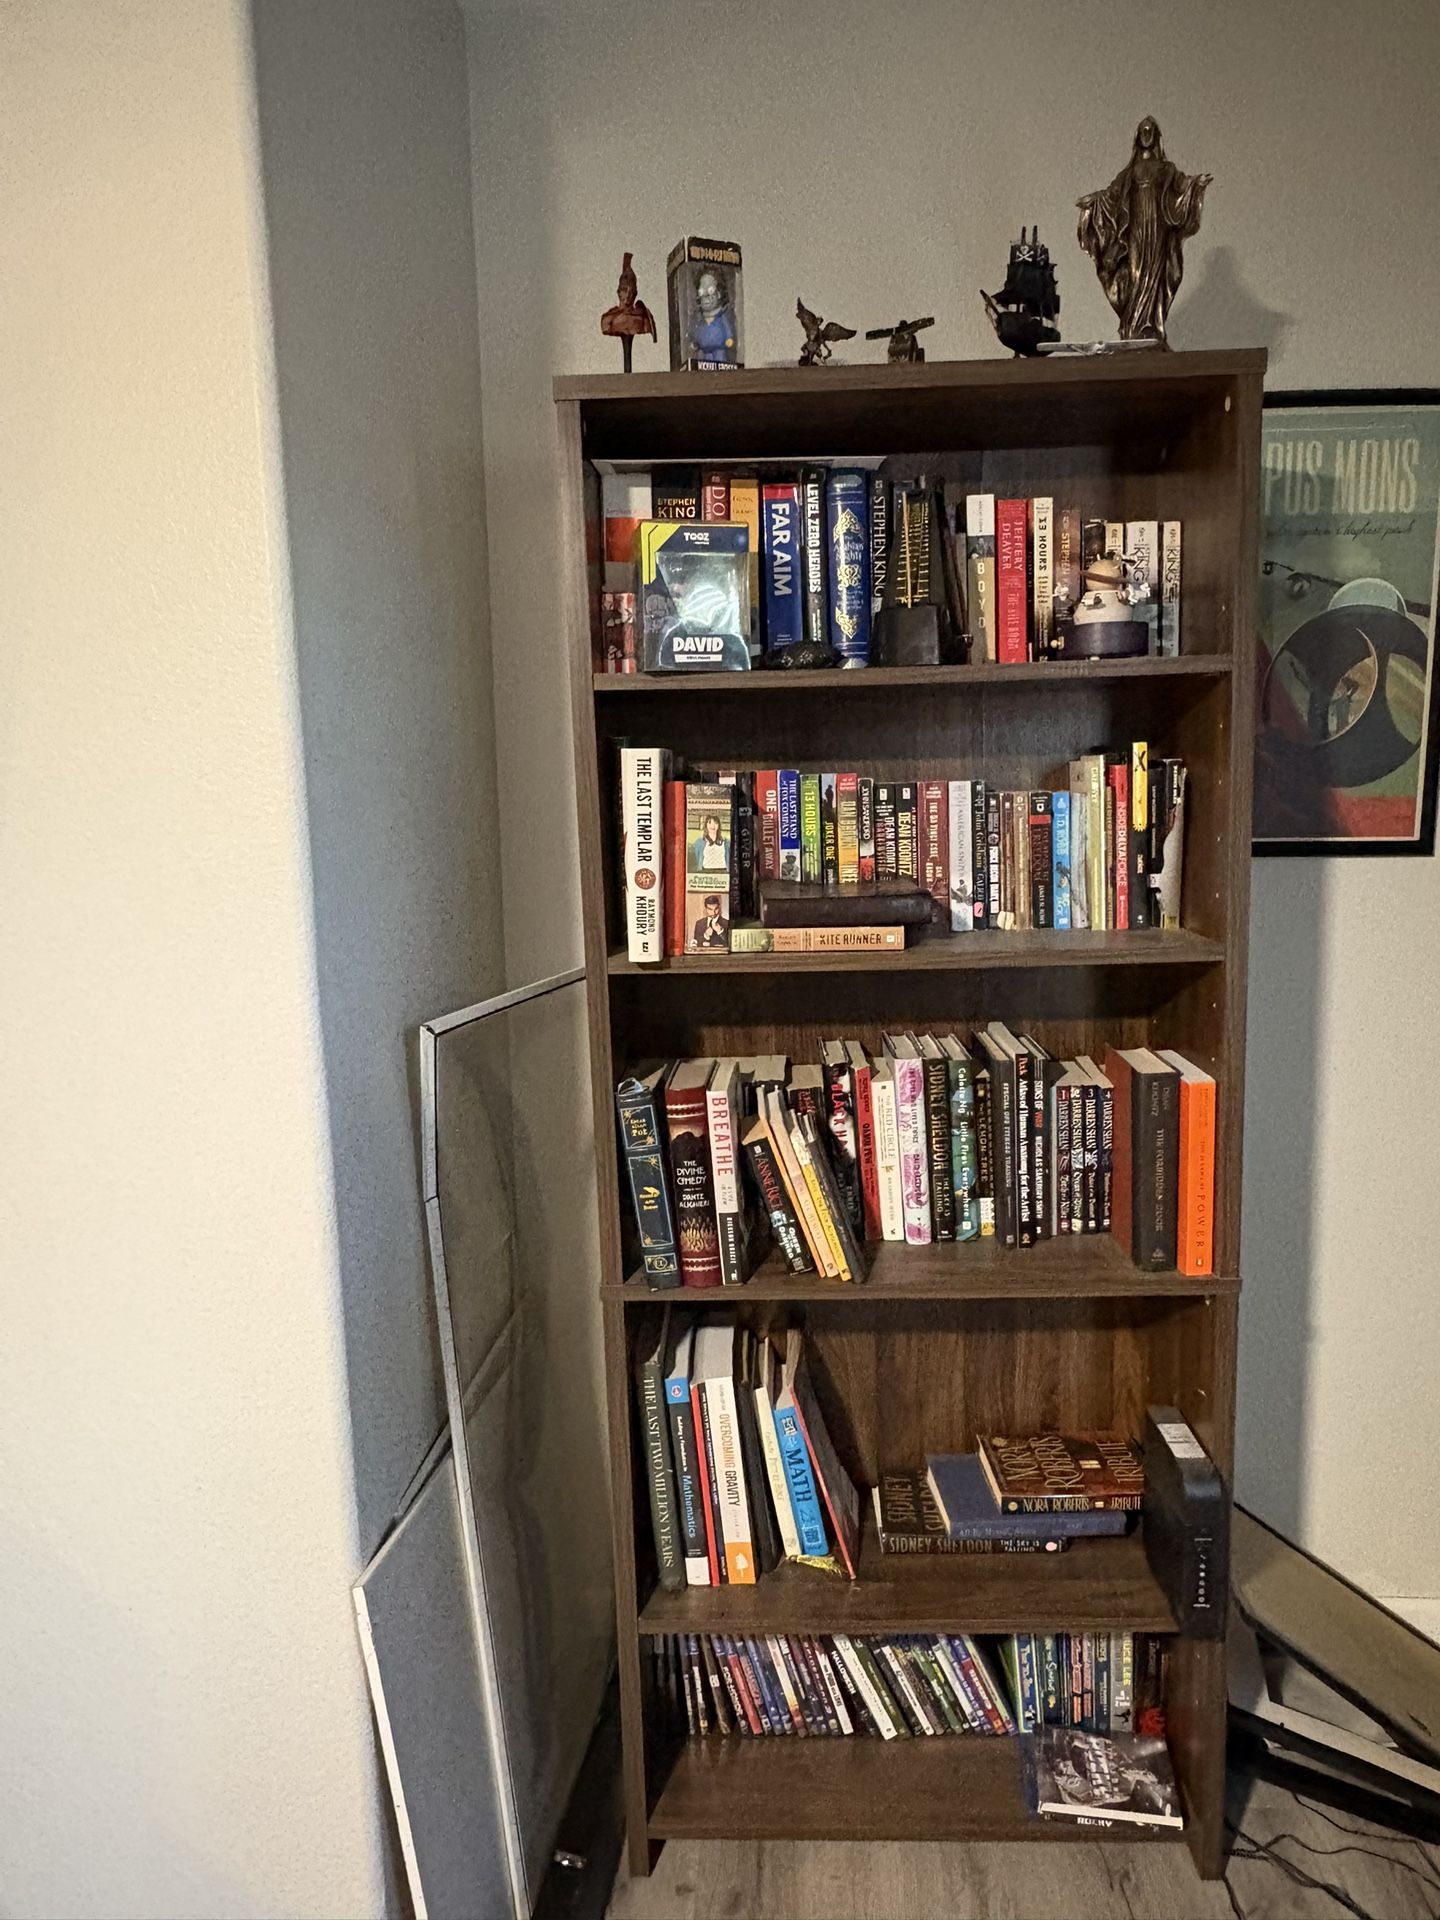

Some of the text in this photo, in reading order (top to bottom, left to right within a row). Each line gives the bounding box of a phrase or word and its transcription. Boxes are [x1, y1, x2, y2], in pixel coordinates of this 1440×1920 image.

[1332, 439, 1419, 516] MONS
[658, 507, 696, 518] KING
[873, 496, 885, 557] STEPHEN
[771, 503, 792, 596] FAR AIM
[807, 483, 821, 593] LEVEL ZERO HEROES
[1002, 523, 1011, 570] DEAVER
[1014, 521, 1023, 571] JEFFERY
[1039, 536, 1047, 571] HOURS
[1061, 533, 1070, 575] STEPHEN
[1133, 547, 1145, 582] KING
[1165, 549, 1180, 583] KING
[673, 637, 724, 652] DAVID
[637, 757, 652, 862] THE LAST TEMPLAR
[805, 791, 815, 801] 13
[763, 790, 776, 870] ONE BULLET AWAY
[781, 802, 789, 838] COMPANY
[805, 803, 816, 836] HOURS
[840, 801, 856, 849] DAN BROWN
[741, 829, 751, 868] GIVER
[825, 846, 835, 860] ONE
[884, 817, 896, 873] DEAN KOONTZ
[898, 812, 912, 876] DEAN KOONTZ
[976, 832, 985, 868] Grisham
[1056, 830, 1068, 856] ROBB
[1117, 802, 1127, 886] INSIDE DELTA FORCE
[636, 896, 648, 935] KHOURY
[820, 934, 882, 945] KITE RUNNER
[831, 1084, 846, 1126] BLACK
[1019, 1079, 1028, 1099] Atlas
[1034, 1080, 1043, 1100] SONS
[1034, 1101, 1043, 1110] OF
[711, 1097, 733, 1176] BREATHE
[885, 1107, 895, 1159] RED CIRCLE
[929, 1065, 949, 1170] SIDNEY SHELDON
[979, 1118, 987, 1152] LEMON
[1019, 1110, 1028, 1139] Human
[1058, 1101, 1069, 1150] DARREN SHAN
[1071, 1100, 1082, 1149] DARREN SHAN
[1085, 1099, 1097, 1149] DARREN SHAN
[1102, 1101, 1112, 1149] DARREN SHAN
[957, 1068, 971, 1217] Celeste Ng Little Fires Everywhere
[1018, 1139, 1029, 1174] Anatomy
[1156, 1129, 1164, 1147] THE
[677, 1177, 707, 1185] COMEDY
[755, 1158, 778, 1188] ANNE
[1020, 1175, 1029, 1185] for
[1021, 1186, 1030, 1199] the
[1021, 1200, 1030, 1222] Artist
[1036, 1200, 1044, 1219] SMITH
[1196, 1194, 1205, 1247] POWER
[788, 1227, 801, 1254] QUEEN
[719, 1414, 737, 1468] OVERCOMING
[643, 1377, 673, 1567] THE LAST TWO MILLION YEARS
[785, 1449, 812, 1503] MATH
[998, 1446, 1043, 1481] NORA
[1028, 1436, 1086, 1490] ROBERTS
[682, 1475, 697, 1538] Mathematics
[725, 1470, 740, 1507] GRAVITY
[1023, 1499, 1048, 1512] NORA
[1053, 1498, 1089, 1511] ROBERTS
[889, 1538, 992, 1552] SIDNEY SHELDON
[722, 1666, 743, 1716] FOR HONOR
[831, 1651, 856, 1694] HALLOWEEN
[1123, 1667, 1131, 1686] LEE
